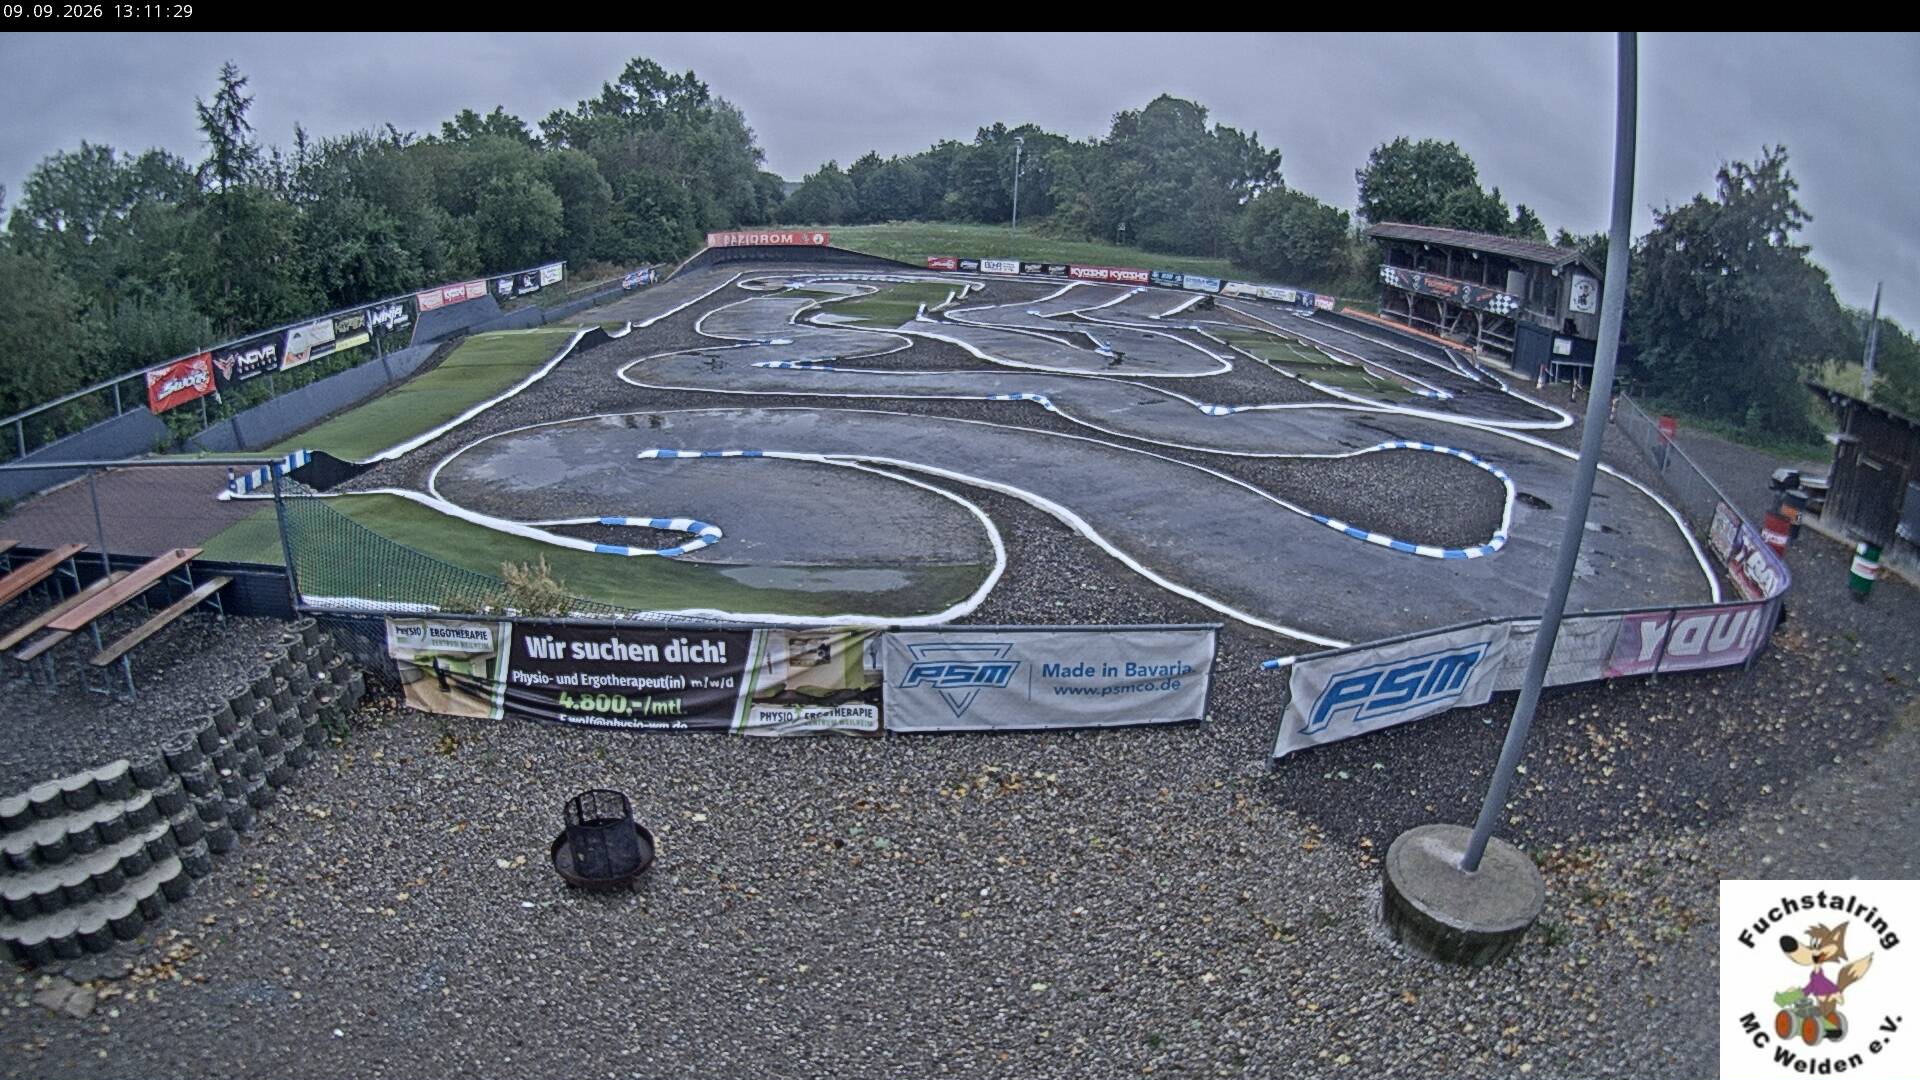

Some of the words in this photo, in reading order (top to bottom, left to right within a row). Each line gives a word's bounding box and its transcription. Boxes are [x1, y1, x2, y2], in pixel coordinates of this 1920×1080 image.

[238, 345, 275, 367] NOVA
[396, 626, 422, 636] PHYSIO
[430, 628, 488, 641] ERGOTHERAPIE
[525, 635, 566, 660] Wir
[571, 638, 659, 662] suchen
[664, 639, 727, 663] dich!
[513, 670, 554, 686] Physio-
[557, 673, 579, 685] und
[581, 673, 686, 690] Ergotherapeut(in)
[691, 676, 734, 688] m/w/d
[907, 663, 1012, 685] PSM
[1042, 662, 1095, 678] Made
[1102, 662, 1118, 677] in
[1053, 679, 1181, 697] www.psmco.de
[1310, 650, 1483, 725] PSM
[760, 711, 793, 722] PHYSIO
